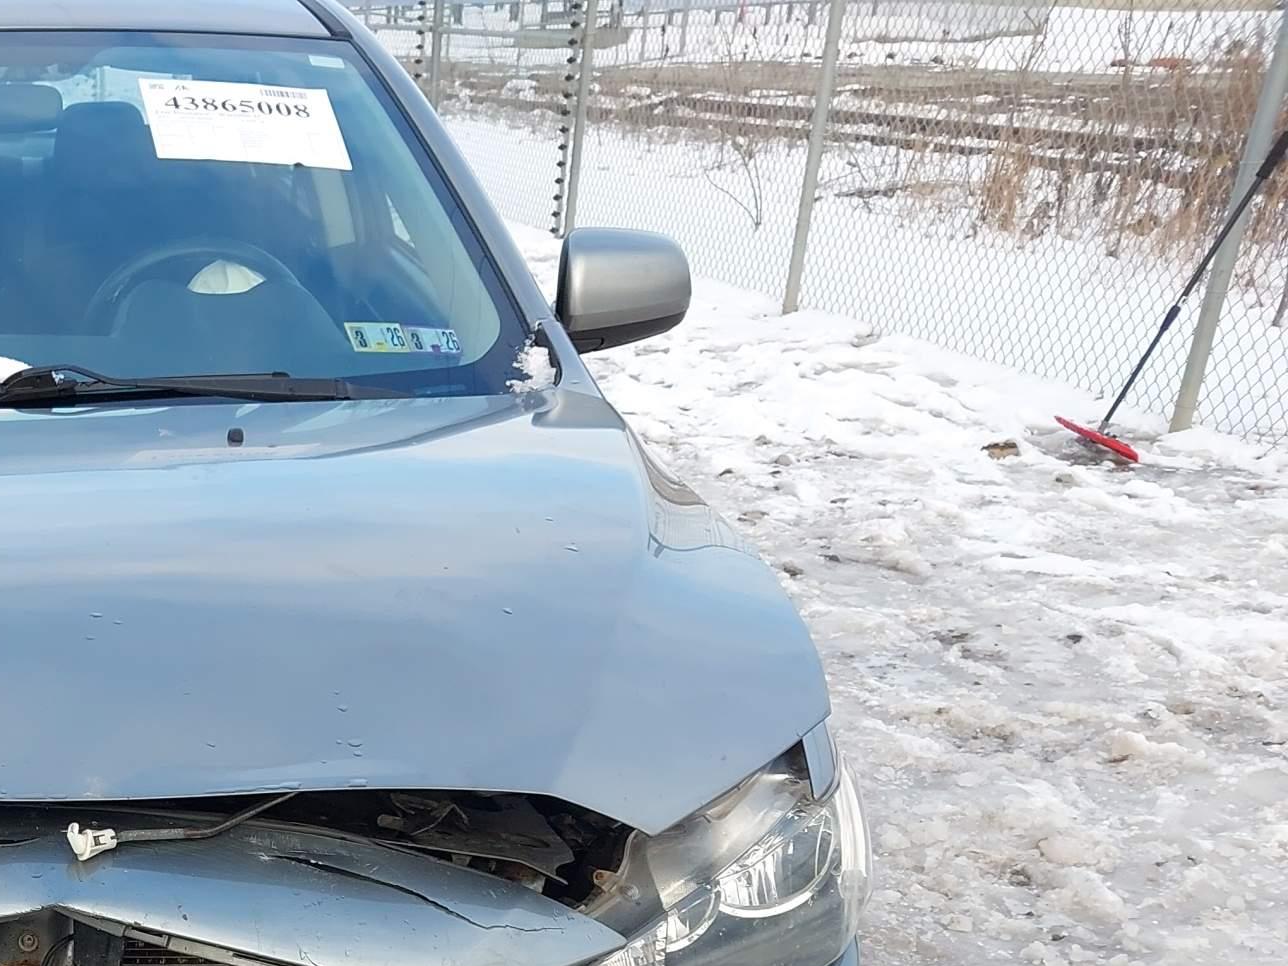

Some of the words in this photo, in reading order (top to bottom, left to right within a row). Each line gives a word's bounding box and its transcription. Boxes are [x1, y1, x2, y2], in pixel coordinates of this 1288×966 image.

[164, 96, 311, 119] 43865008
[355, 330, 368, 348] 3
[386, 327, 405, 347] 26
[411, 332, 423, 350] 3
[441, 331, 460, 351] 26
